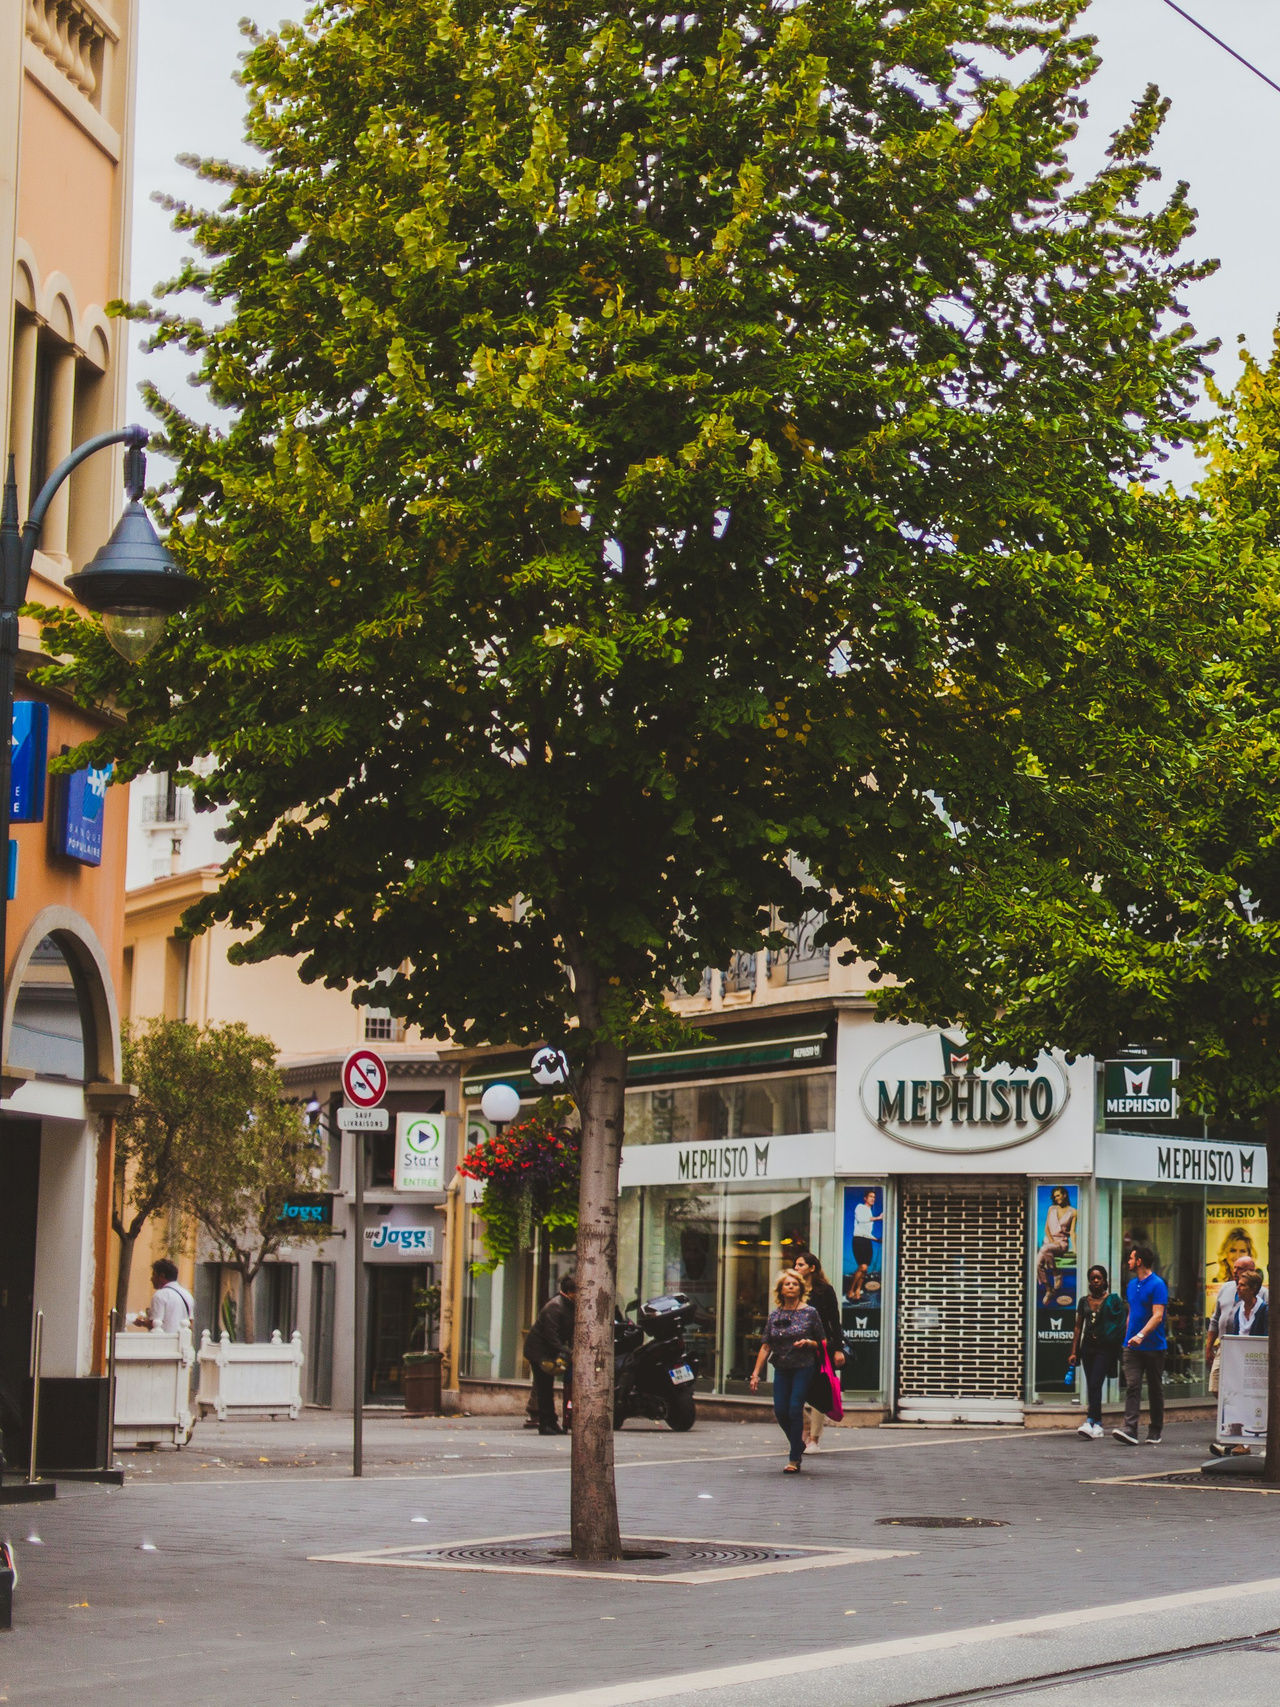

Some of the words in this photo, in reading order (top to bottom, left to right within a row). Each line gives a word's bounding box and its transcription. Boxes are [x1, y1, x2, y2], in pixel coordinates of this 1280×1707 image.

[69, 823, 101, 844] BANQUE
[68, 837, 100, 858] POPULAIRE
[876, 1076, 1053, 1125] MEPHISTO
[1107, 1098, 1170, 1113] MEPHISTO
[404, 1153, 439, 1167] Start
[678, 1145, 748, 1180] MEPHISTO
[1157, 1146, 1234, 1182] MEPHISTO
[403, 1177, 438, 1187] ENTRÉE
[277, 1202, 323, 1221] Jogg
[1206, 1207, 1256, 1218] MEPHISTO
[373, 1226, 426, 1249] Jogg
[843, 1330, 879, 1338] MEPHISTO
[1038, 1331, 1075, 1340] MEPHISTO
